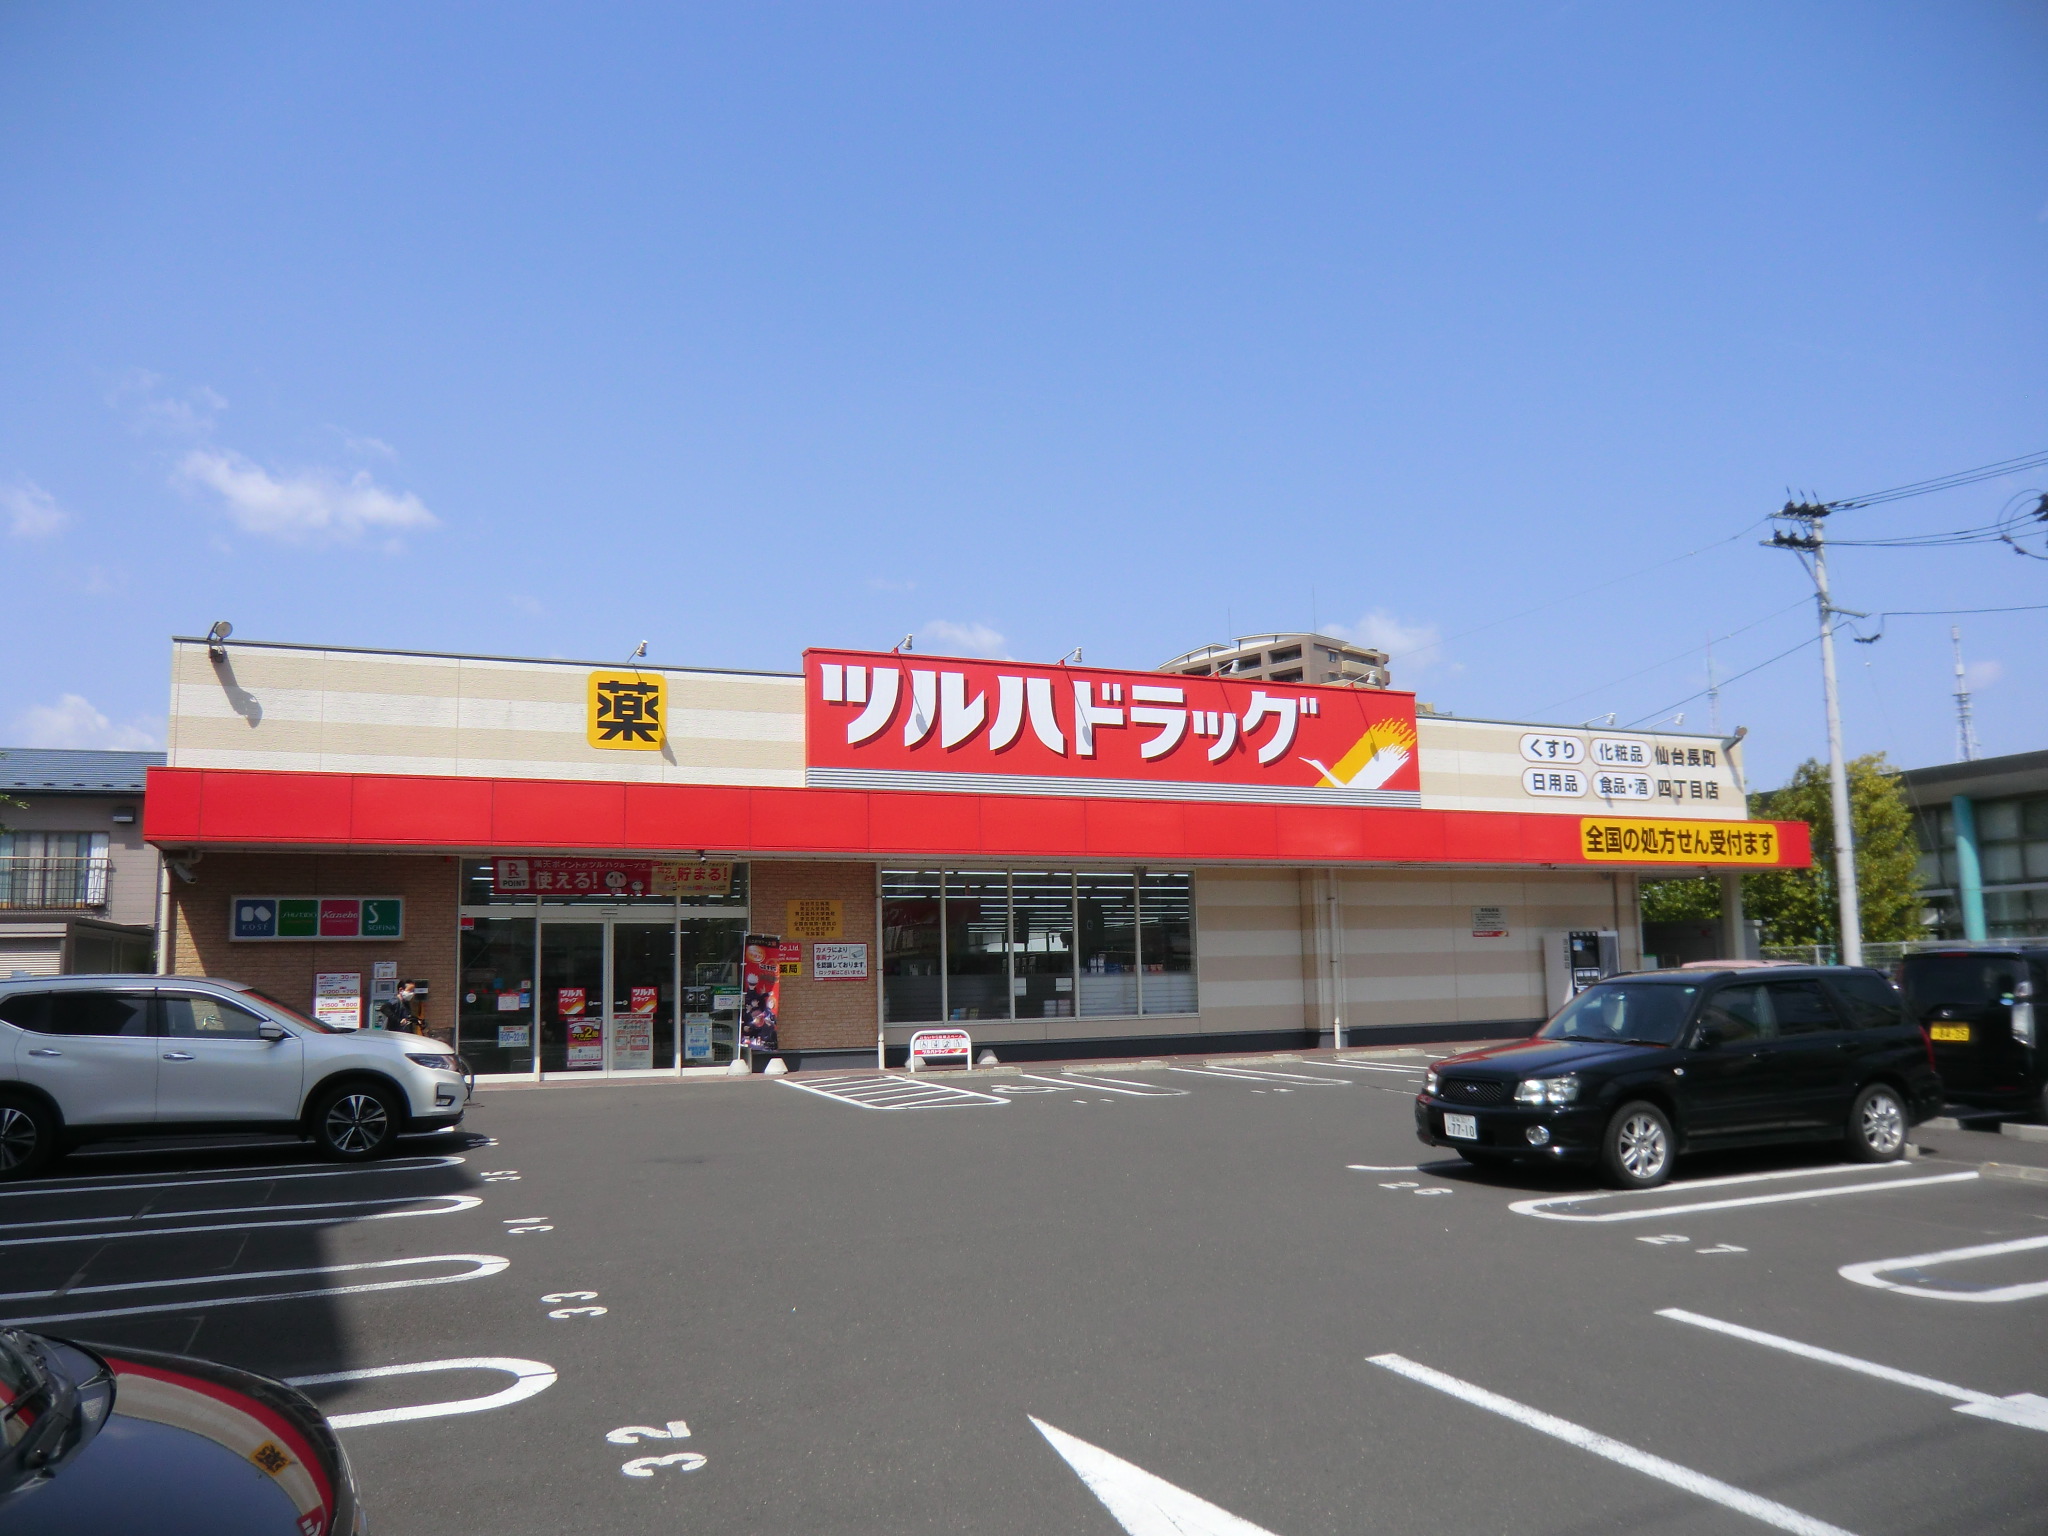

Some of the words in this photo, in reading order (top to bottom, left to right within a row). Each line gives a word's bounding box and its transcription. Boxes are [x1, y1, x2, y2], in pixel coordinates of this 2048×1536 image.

[597, 681, 659, 741] 薬
[821, 664, 1318, 765] ツルハドラッグ
[1531, 739, 1575, 759] くすり
[1600, 744, 1643, 763] 化粧品
[1655, 746, 1716, 768] 仙台長町
[1533, 773, 1578, 792] 日用品
[1600, 777, 1648, 796] 食品・酒
[1658, 779, 1719, 800] 四丁目店
[1586, 825, 1774, 856] 全国の処方せん受付ます
[322, 910, 358, 919] Kanebo
[560, 989, 583, 997] ツルハ
[633, 988, 655, 996] ツルハ
[541, 1291, 608, 1319] 33
[606, 1420, 707, 1478] 32
